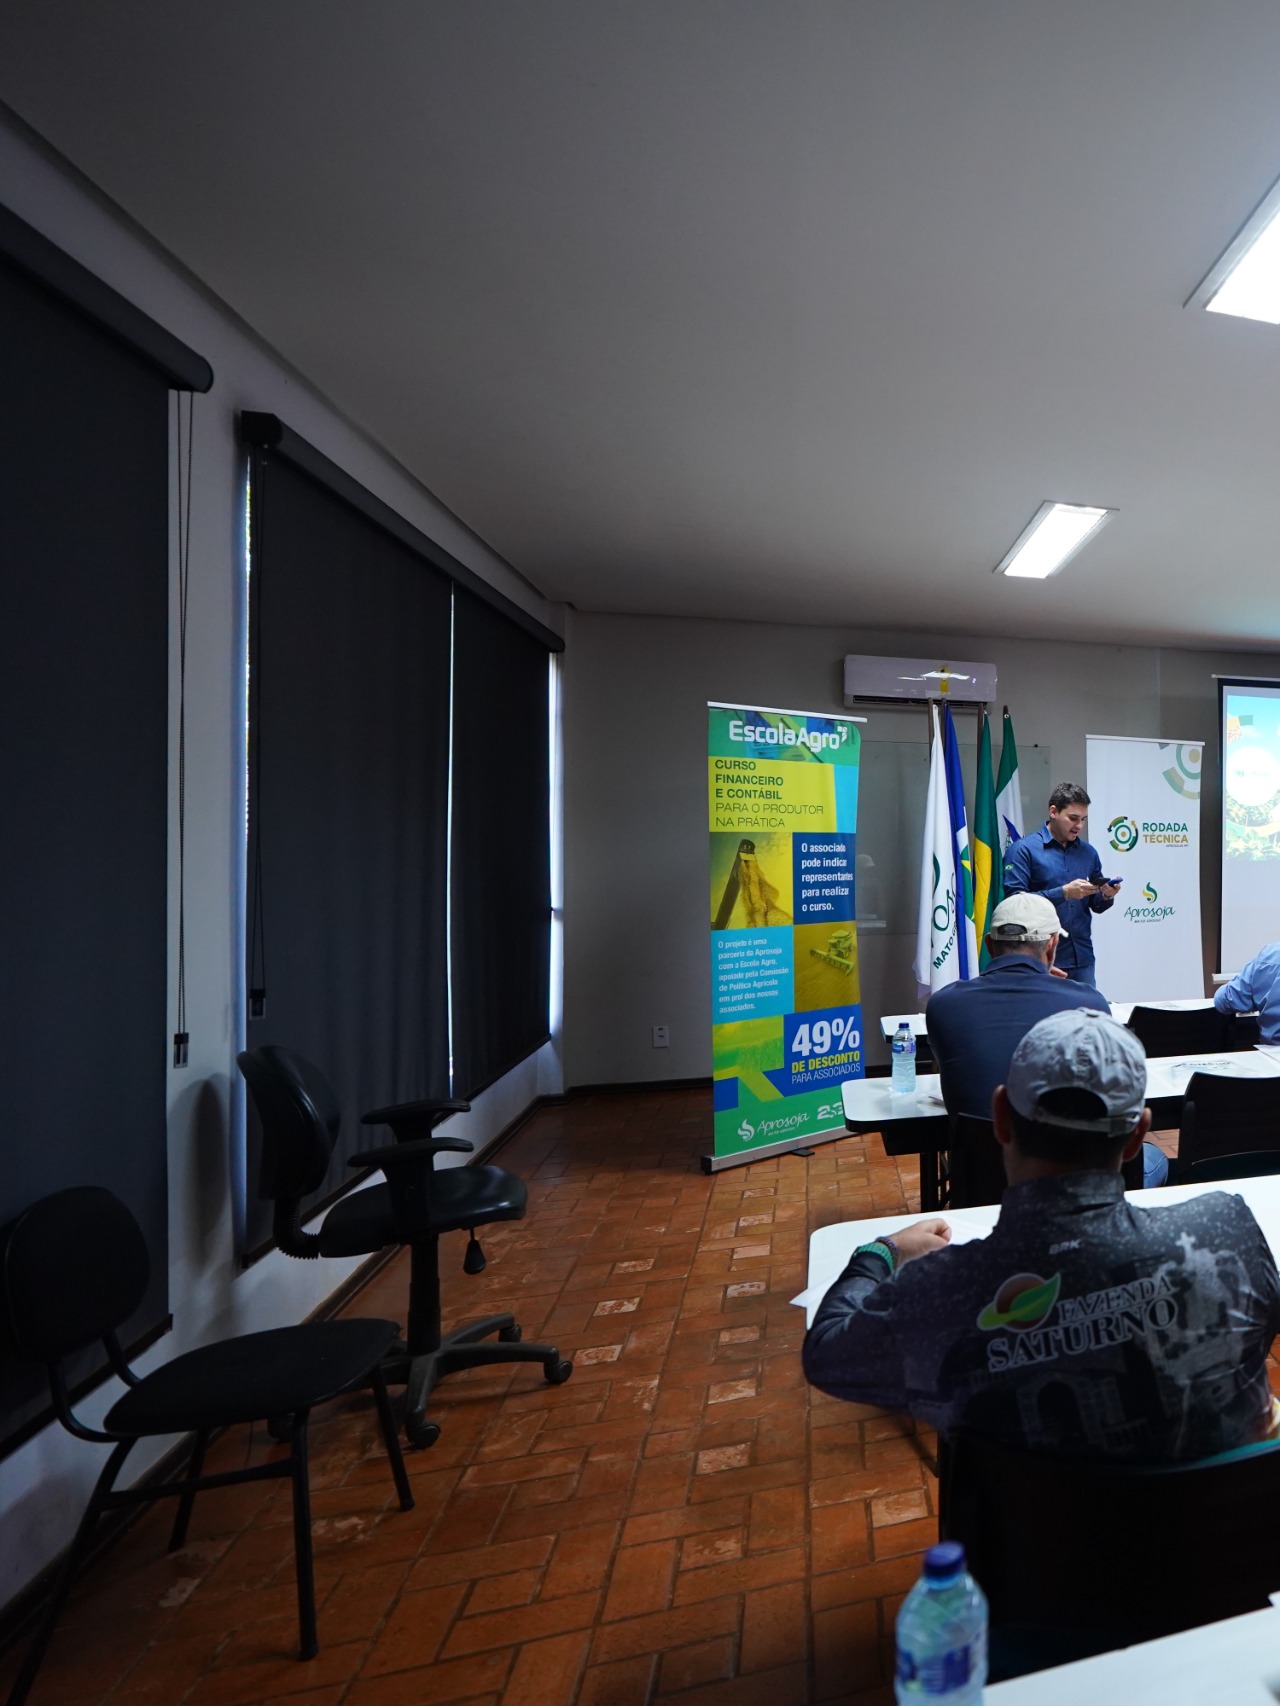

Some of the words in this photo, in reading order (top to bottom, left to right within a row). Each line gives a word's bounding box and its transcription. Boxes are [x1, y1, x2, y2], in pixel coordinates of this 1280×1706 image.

[729, 720, 840, 752] EscolaAgro
[715, 759, 756, 771] CURSO
[715, 774, 784, 786] FINANCEIRO
[715, 788, 723, 798] E
[727, 787, 782, 800] CONTÁBIL
[715, 802, 748, 813] PARA
[751, 804, 761, 814] O
[763, 803, 824, 815] PRODUTOR
[715, 817, 735, 827] NA
[737, 815, 785, 828] PRÁTICA
[1142, 822, 1188, 832] RODADA
[1143, 833, 1188, 843] TÉCNICA
[801, 843, 808, 853] O
[802, 857, 821, 870] pode
[802, 889, 820, 899] para
[802, 904, 807, 912] o
[809, 902, 834, 911] curso.
[1124, 906, 1176, 921] Aprosoja
[718, 941, 724, 949] O
[725, 940, 747, 949] projeto
[718, 950, 745, 960] parceria
[755, 947, 782, 957] Aprosoja
[933, 937, 954, 969] MATO
[740, 959, 759, 968] Escola
[745, 970, 759, 979] pela
[760, 967, 789, 976] Comissão
[729, 982, 751, 990] Política
[753, 979, 778, 988] Agrícola
[731, 993, 743, 1002] prol
[757, 990, 778, 998] nossos
[791, 1016, 861, 1057] 49%
[791, 1061, 805, 1074] DE
[808, 1051, 860, 1071] DESCONTO
[791, 1073, 812, 1084] PARA
[813, 1062, 861, 1081] ASSOCIADOS
[757, 1111, 811, 1136] Aprosoja
[1057, 1274, 1180, 1325] FAZENDA
[987, 1296, 1178, 1373] SATURNO
